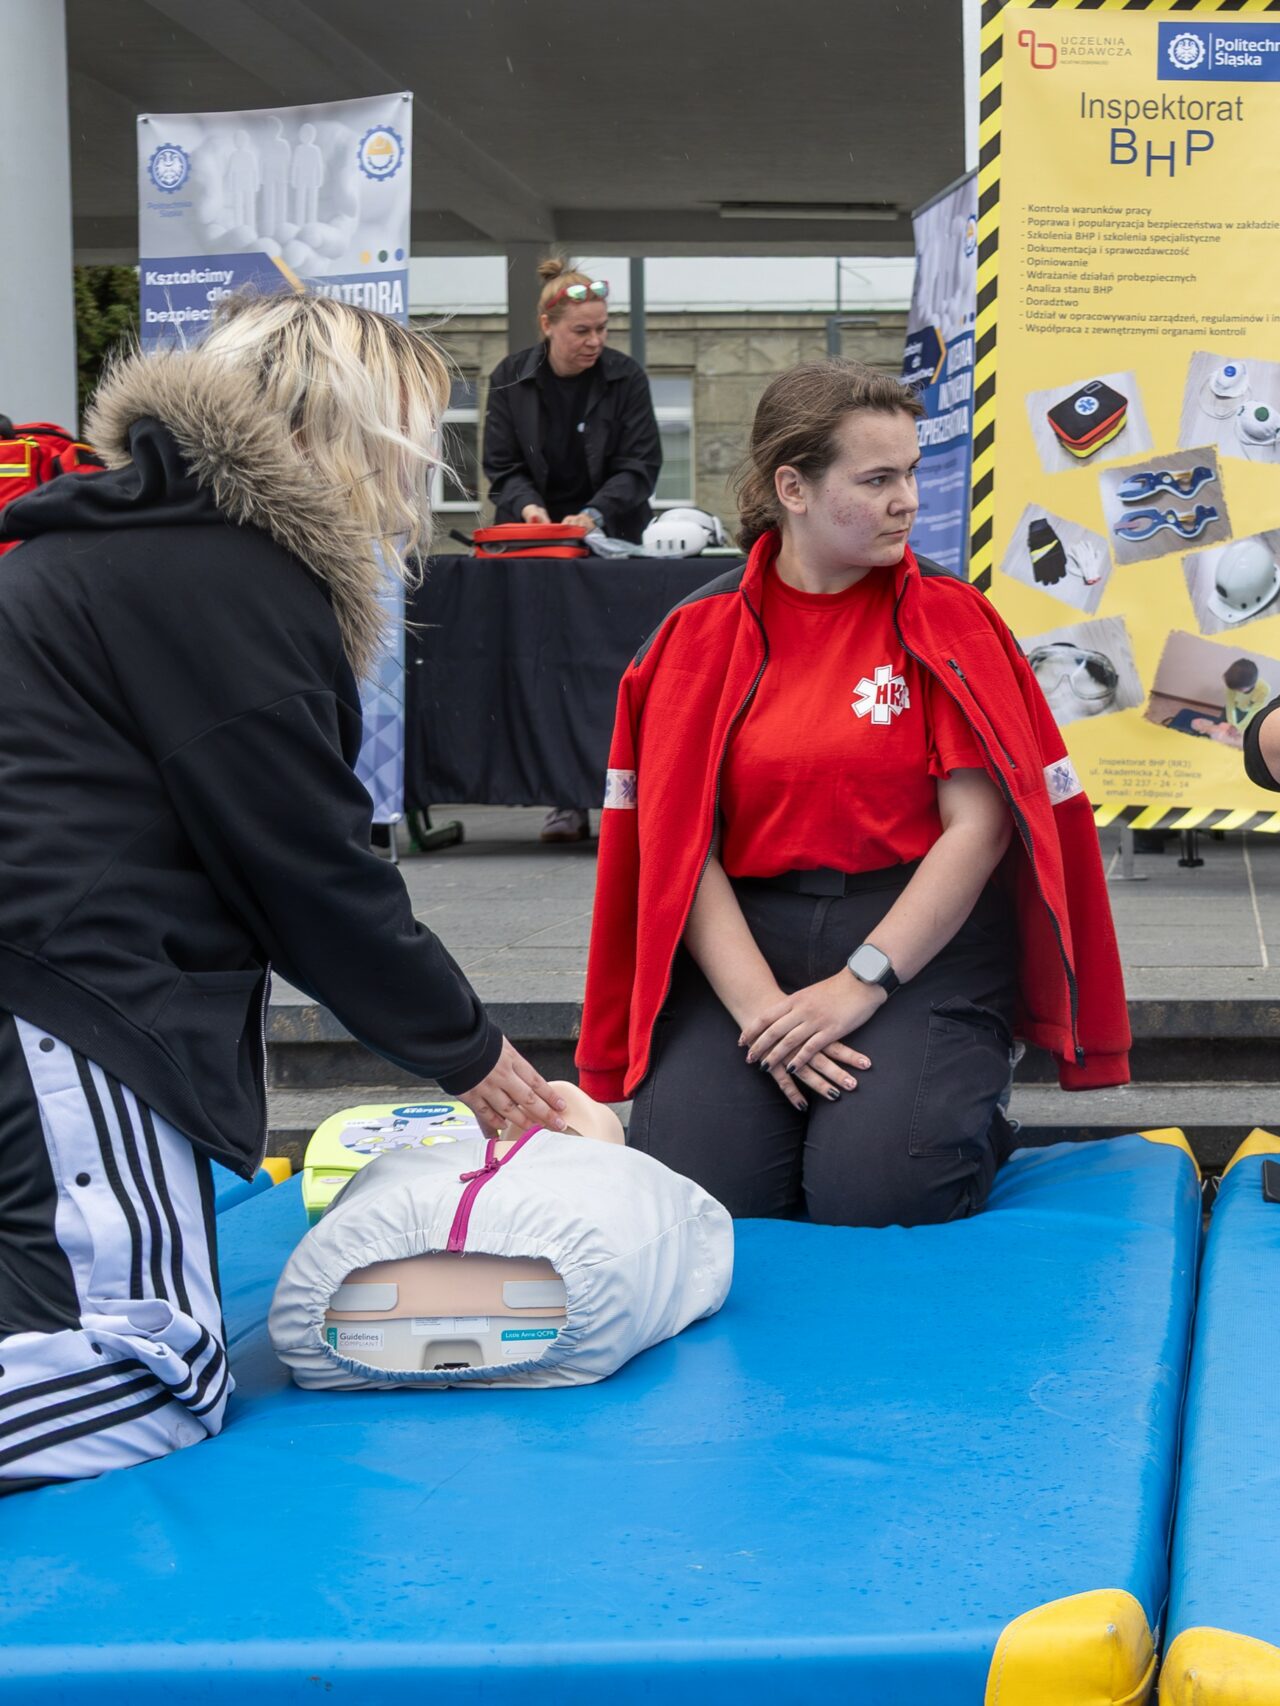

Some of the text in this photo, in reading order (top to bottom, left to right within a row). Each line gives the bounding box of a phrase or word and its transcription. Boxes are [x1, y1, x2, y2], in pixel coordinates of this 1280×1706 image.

[1061, 36, 1125, 46] UCZELNIA
[1061, 47, 1133, 56] BADAWCZA
[1215, 51, 1262, 67] Śląska
[1081, 92, 1243, 126] Inspektorat
[1110, 128, 1214, 177] BHP
[1028, 204, 1152, 216] Kontrola warunków pracy
[1028, 217, 1069, 228] Poprawa
[1078, 218, 1144, 229] popularyzacja
[1147, 219, 1222, 229] bezpieczeństwa
[1236, 220, 1280, 230] zakładzie
[1027, 231, 1072, 240] Szkolenia
[1075, 232, 1095, 240] BHP
[1103, 232, 1147, 242] szkolenia
[1150, 233, 1221, 244] specjalistyczne
[1027, 244, 1097, 255] Dokumentacja
[1105, 246, 1189, 256] sprawozdawczość
[1027, 257, 1088, 267] Opiniowanie
[145, 268, 234, 285] Kształcimy
[1027, 270, 1077, 280] Wdrażanie
[1117, 273, 1196, 284] probezpiecznych
[1026, 284, 1113, 294] Analiza stanu BHP
[1026, 297, 1079, 307] Doradztwo
[1026, 311, 1056, 319] Udział
[1070, 312, 1146, 322] opracowywaniu
[1201, 314, 1263, 324] regulaminów
[1025, 323, 1081, 334] Współpraca
[1092, 326, 1158, 336] zewnętrznymi
[1161, 327, 1206, 337] organami
[1209, 327, 1246, 336] kontroli
[340, 1332, 379, 1341] Guidelines
